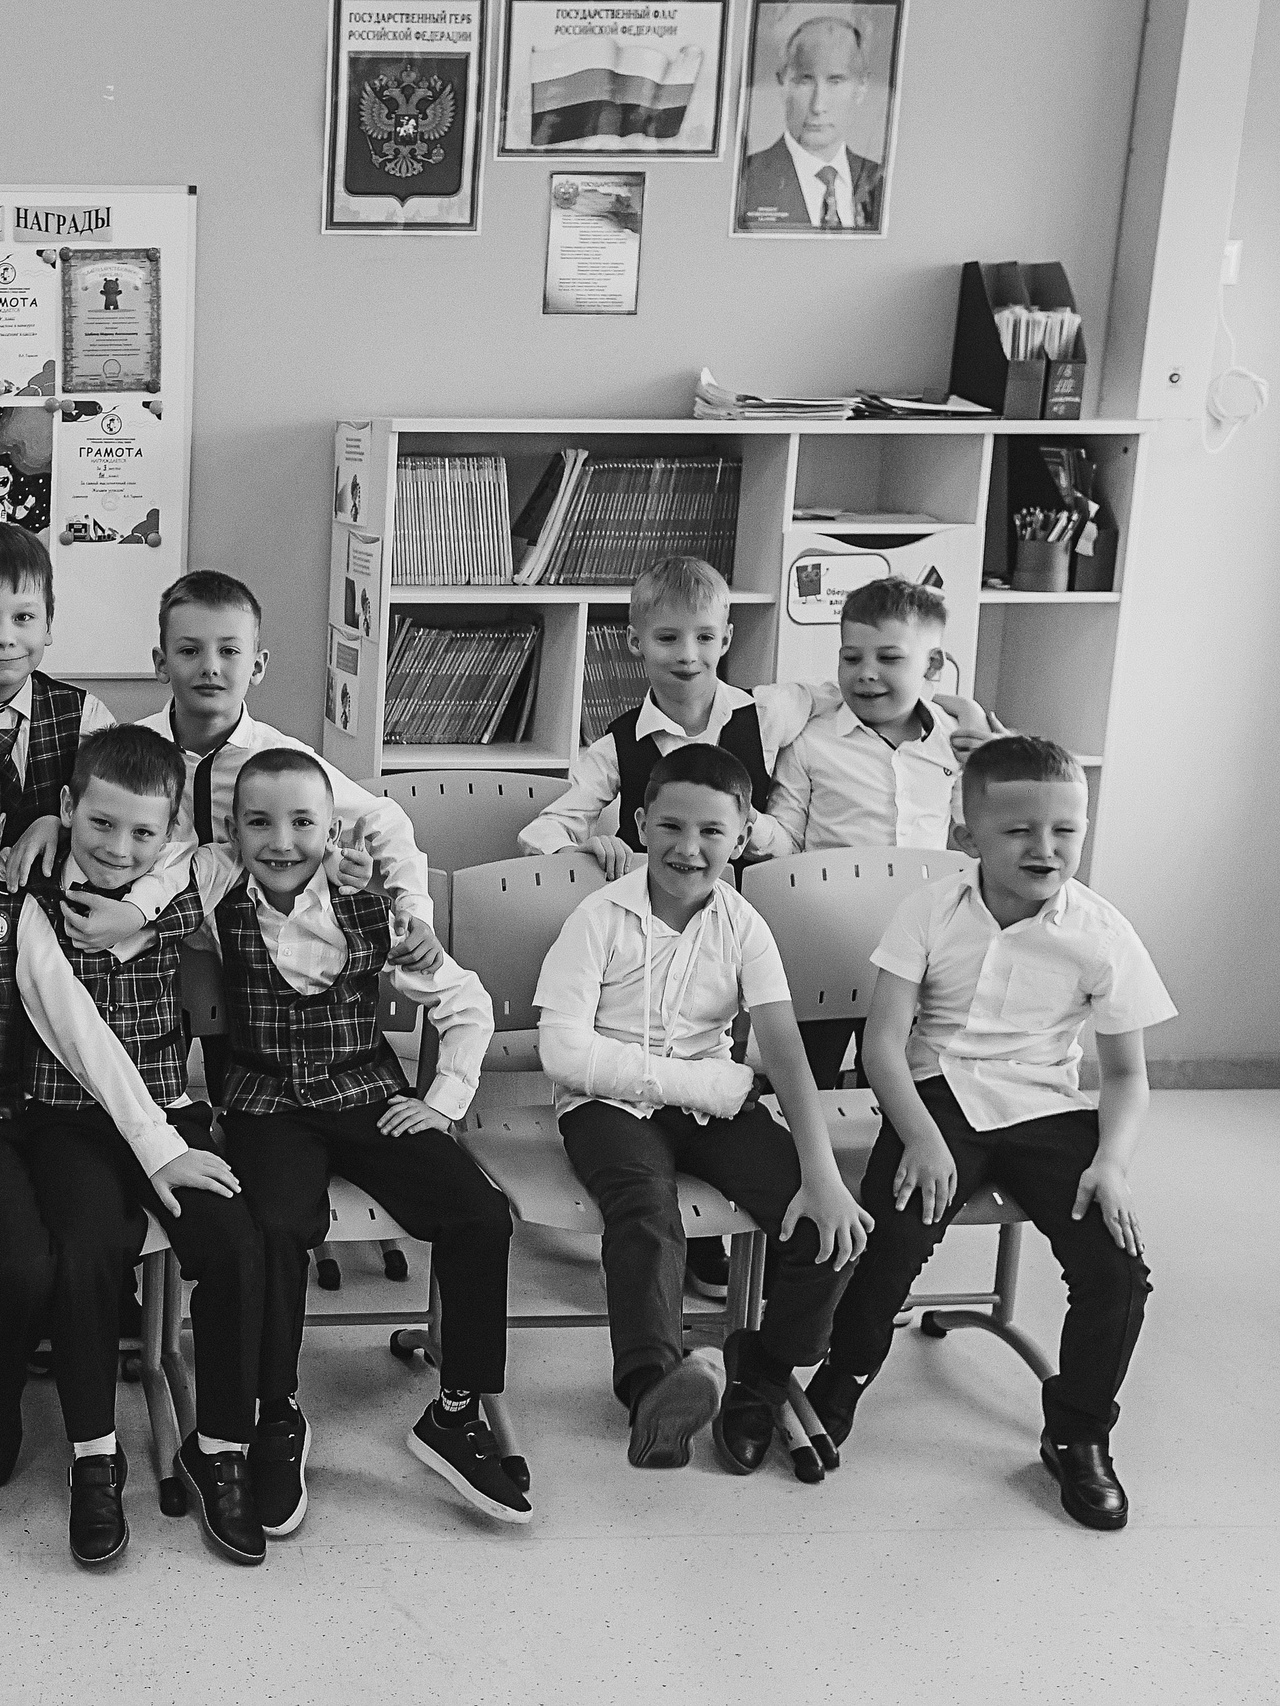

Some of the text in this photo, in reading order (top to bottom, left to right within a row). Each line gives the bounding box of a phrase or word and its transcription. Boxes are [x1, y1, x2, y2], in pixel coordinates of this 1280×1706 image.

[349, 10, 472, 24] ГОСУДАРСТВЕННЫЙ ГЕРБ
[348, 27, 472, 43] РОССИЙСКОЙ ФЕДЕРАЦИИ
[554, 22, 678, 38] РОССИЙСКОЙ ФЕДЕРАЦИИ
[15, 206, 111, 237] НАГРАДЫ
[79, 447, 143, 458] ГРАМОТА
